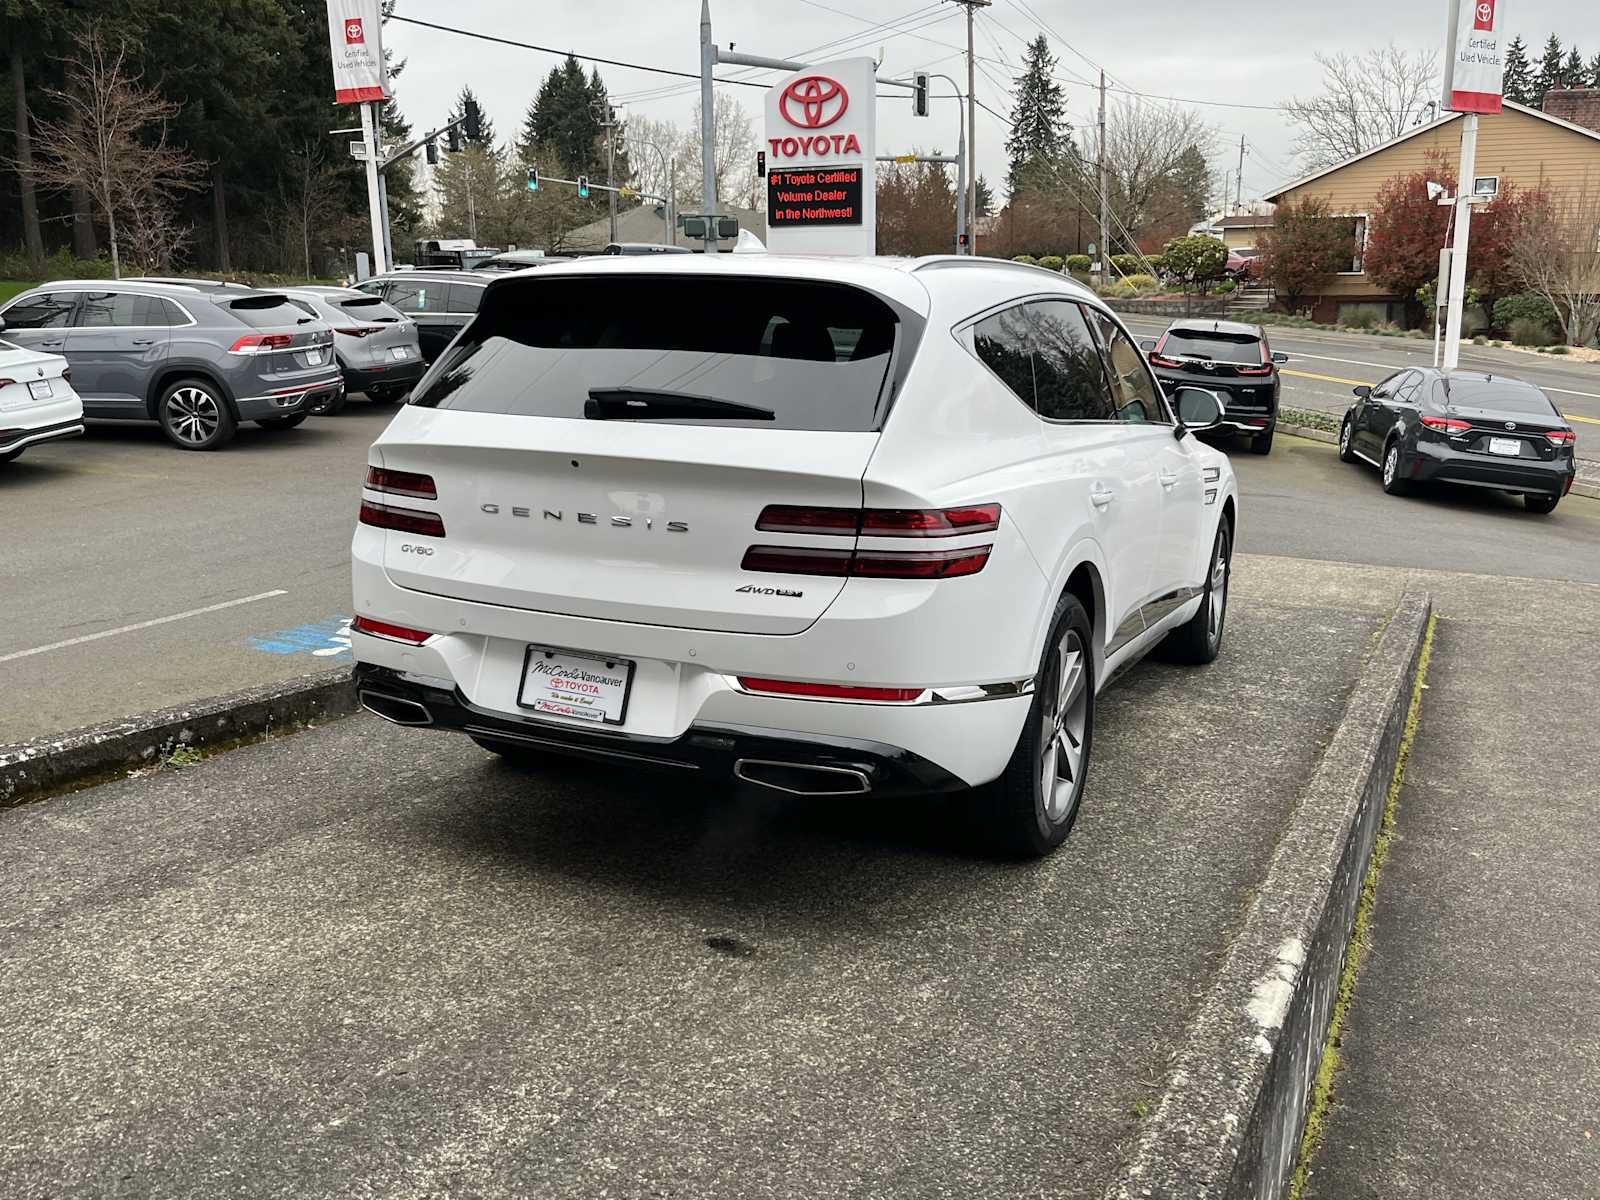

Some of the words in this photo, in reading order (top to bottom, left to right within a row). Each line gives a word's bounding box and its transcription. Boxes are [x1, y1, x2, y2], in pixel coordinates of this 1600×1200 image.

[1469, 38, 1497, 50] Certified
[1460, 51, 1476, 63] Used
[768, 134, 861, 158] TOYOTA
[770, 174, 782, 186] #1
[784, 173, 815, 187] Toyota
[816, 170, 857, 184] Certified
[777, 191, 813, 203] Volume
[814, 189, 847, 201] Dealer
[775, 209, 784, 219] in
[785, 208, 801, 219] the
[802, 206, 853, 218] Northwest!
[480, 503, 689, 533] GENESIS
[401, 543, 434, 557] GV80
[581, 671, 622, 688] Vancouver
[565, 680, 599, 695] TOYOTA
